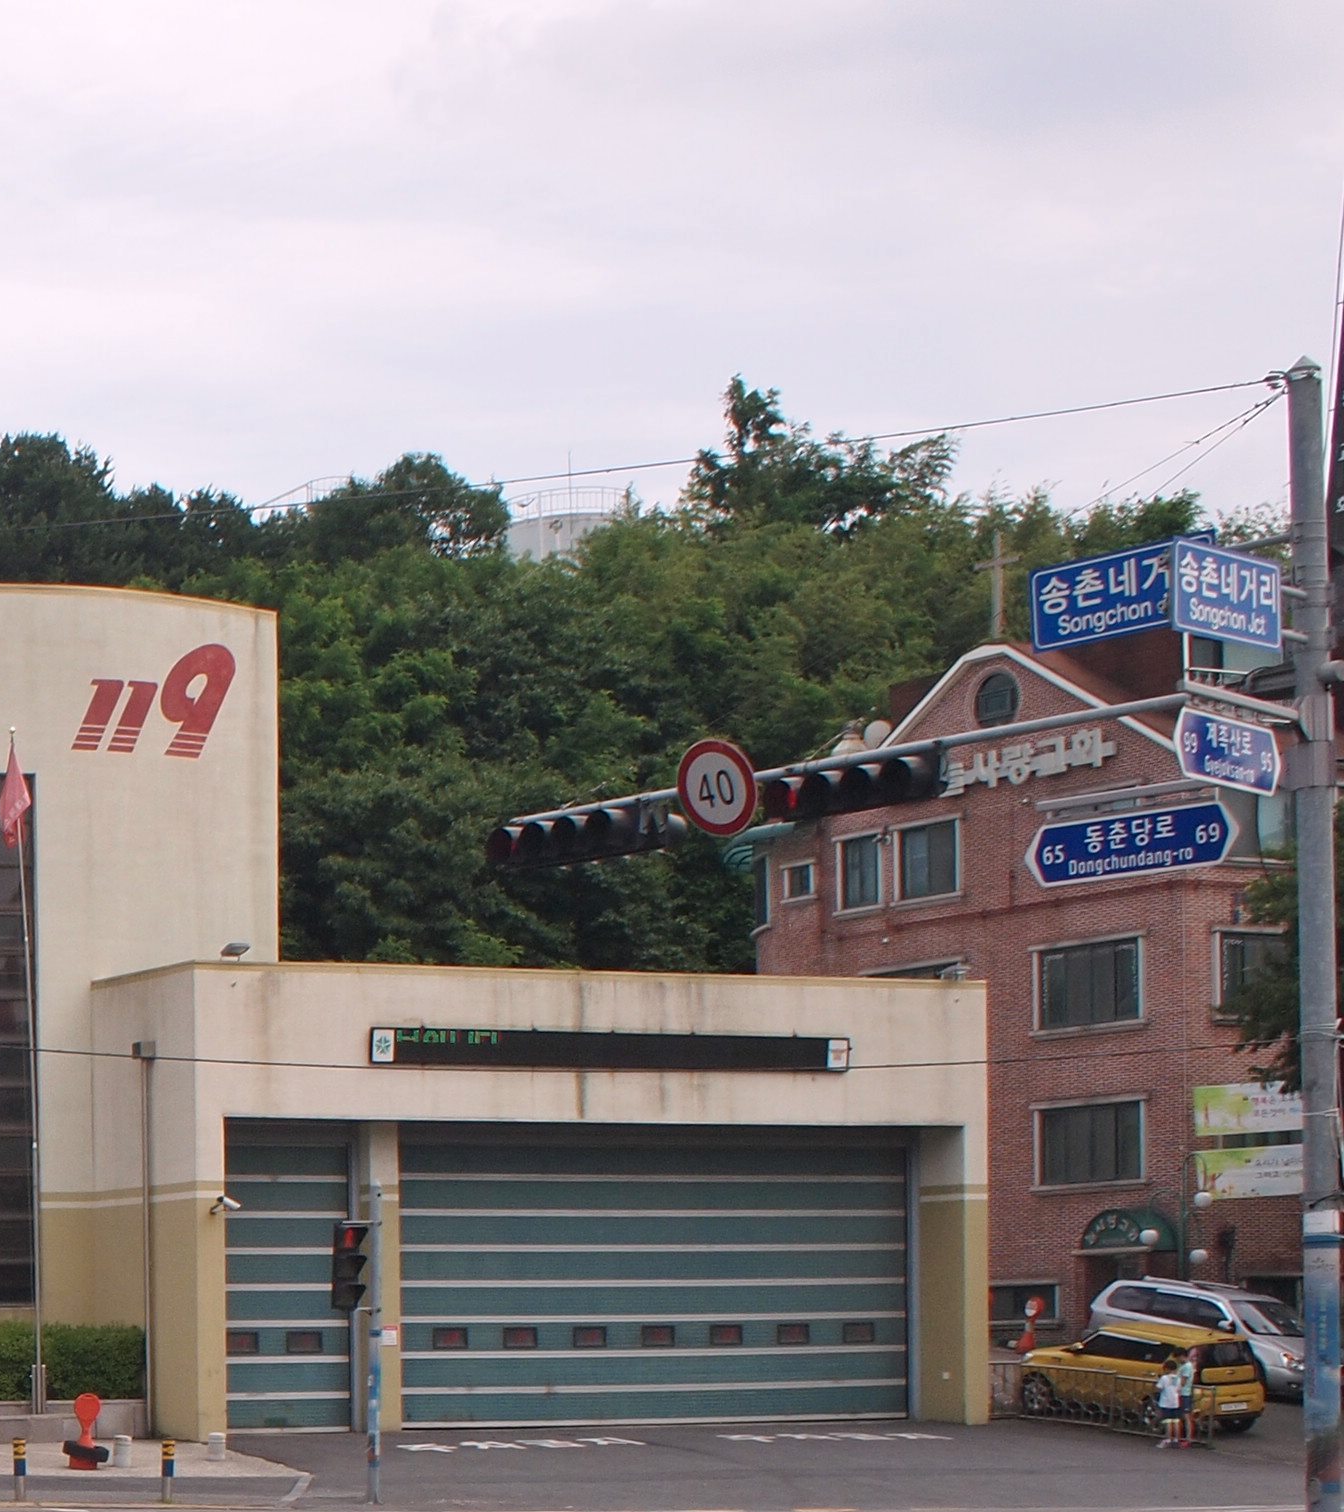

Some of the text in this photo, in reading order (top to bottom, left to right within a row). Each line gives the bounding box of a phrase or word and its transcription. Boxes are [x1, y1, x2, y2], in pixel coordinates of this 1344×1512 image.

[1038, 556, 1170, 614] 송촌네거
[1179, 551, 1277, 614] 송촌네거리
[1058, 599, 1153, 636] Songchon
[1189, 598, 1247, 632] Songchon
[1248, 613, 1267, 637] Jct
[70, 643, 237, 759] 119
[1184, 731, 1199, 753] 99
[1206, 722, 1252, 756] 계족산로
[698, 769, 737, 808] 40
[1083, 815, 1176, 855] 동춘당로
[1195, 823, 1220, 845] 69
[1042, 844, 1066, 866] 65
[1068, 846, 1194, 876] Dongchundang-ro
